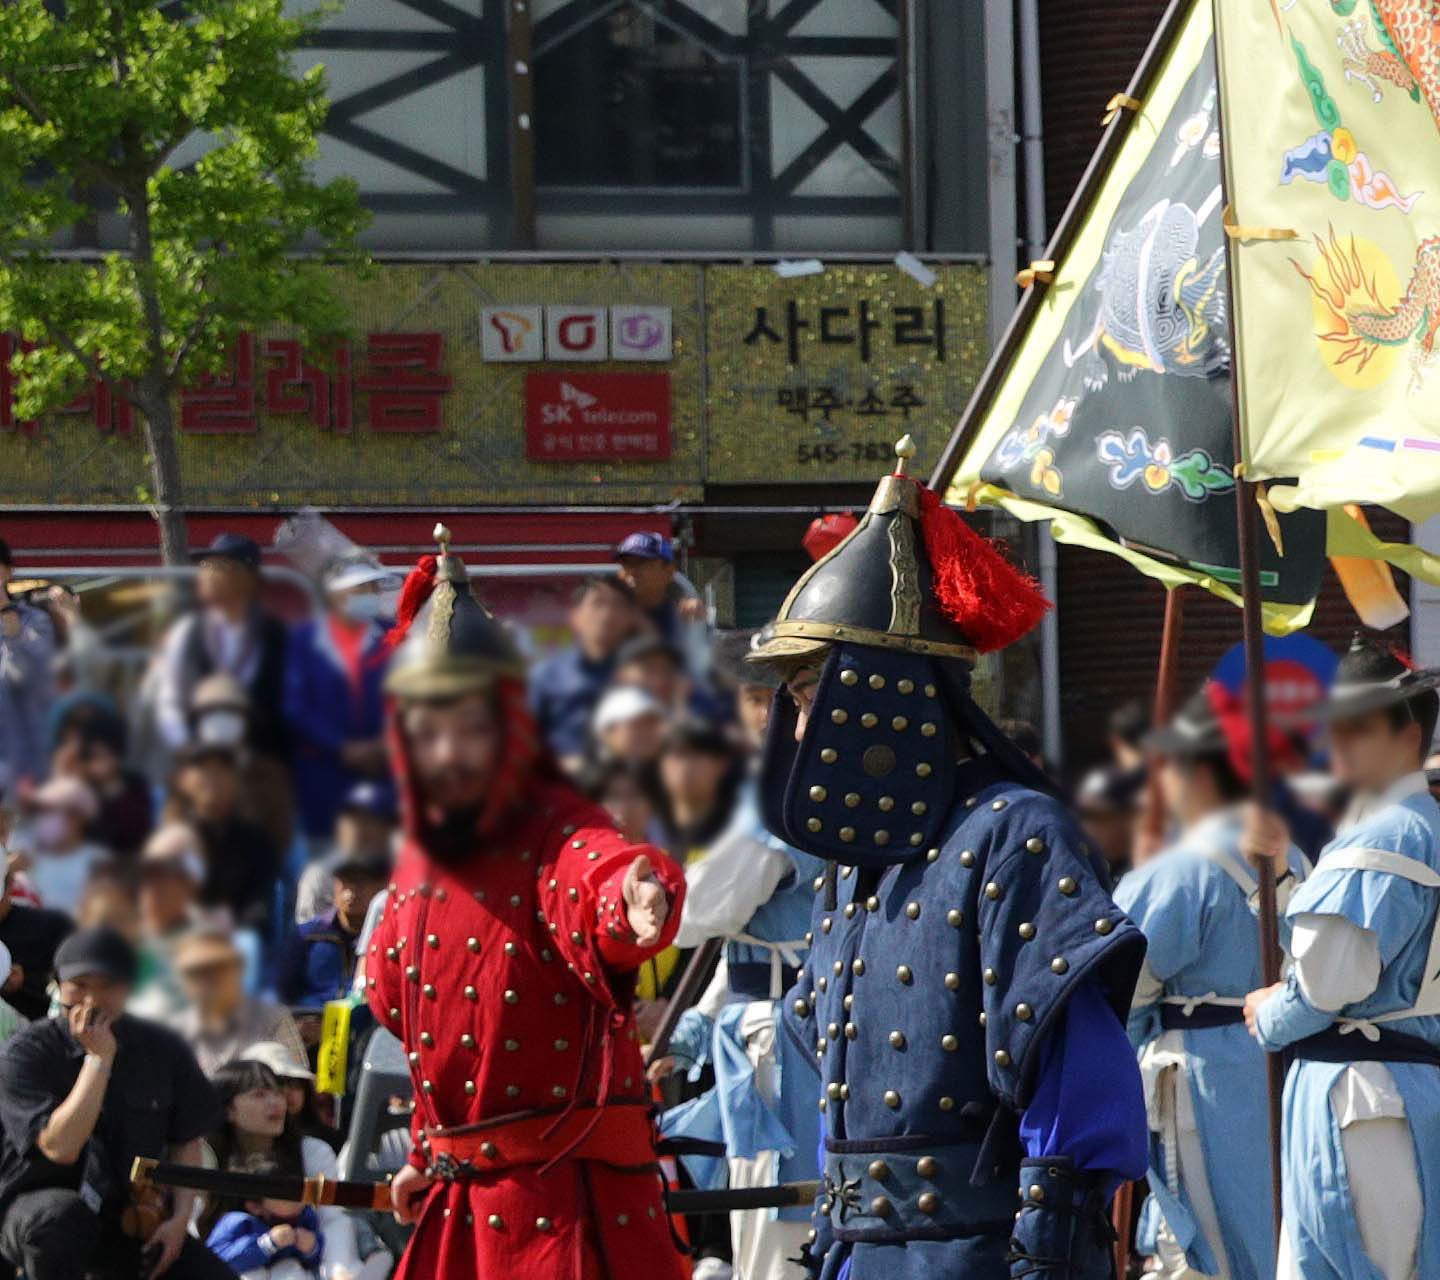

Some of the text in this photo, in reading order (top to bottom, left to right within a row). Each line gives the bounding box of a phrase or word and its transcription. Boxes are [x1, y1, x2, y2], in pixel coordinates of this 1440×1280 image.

[743, 297, 947, 363] 사다리
[541, 403, 658, 424] SK telecom
[797, 443, 897, 464] 545-763
